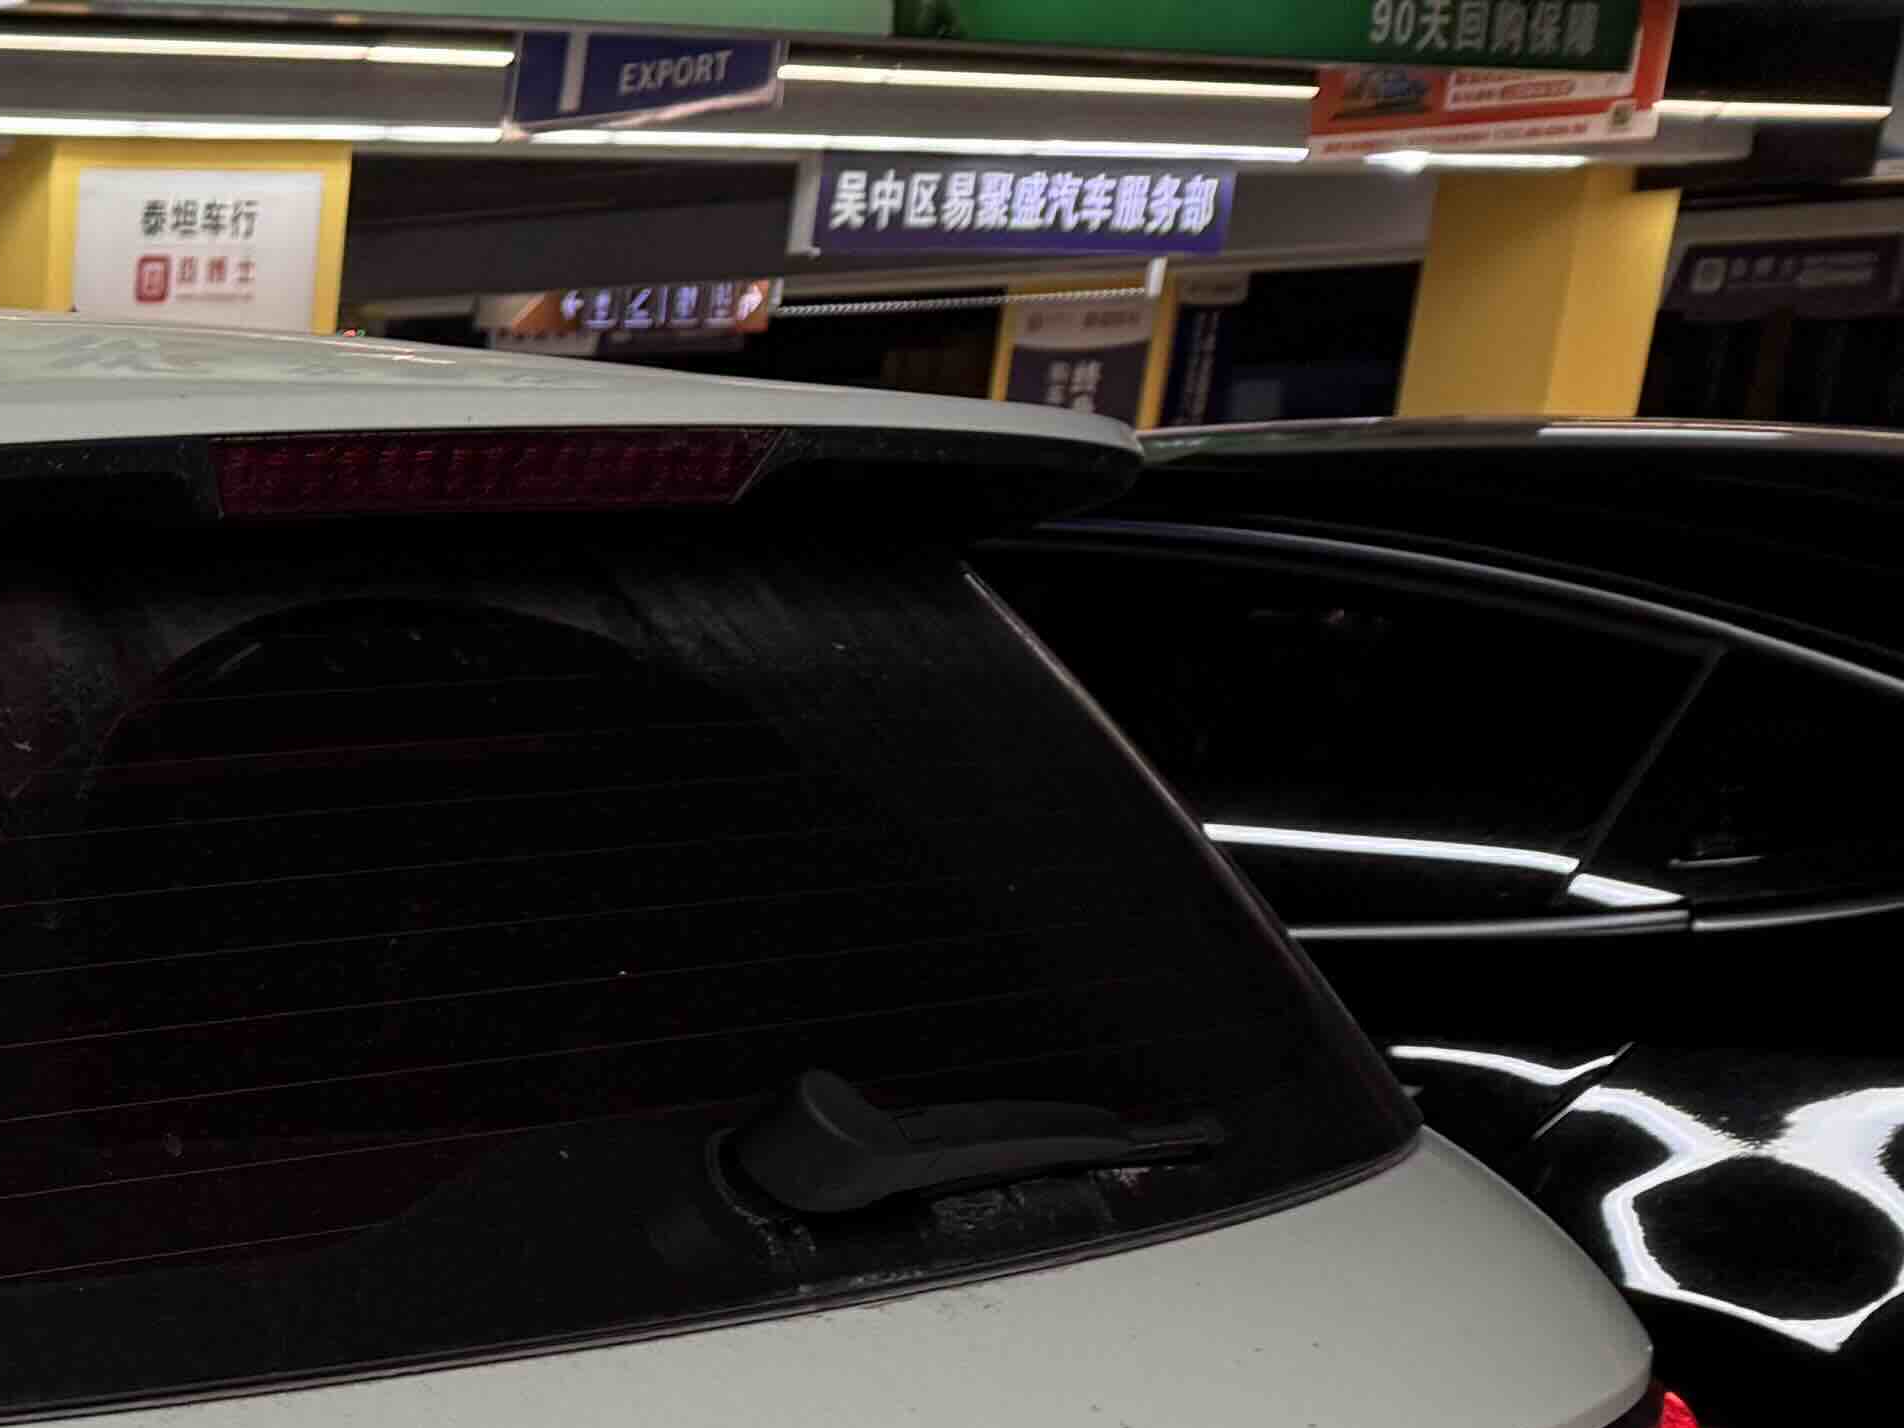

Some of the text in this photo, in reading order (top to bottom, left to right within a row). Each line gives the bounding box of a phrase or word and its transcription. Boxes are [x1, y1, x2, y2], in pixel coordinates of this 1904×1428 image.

[616, 49, 735, 96] EXPORT
[141, 199, 258, 239] 泰坦车行
